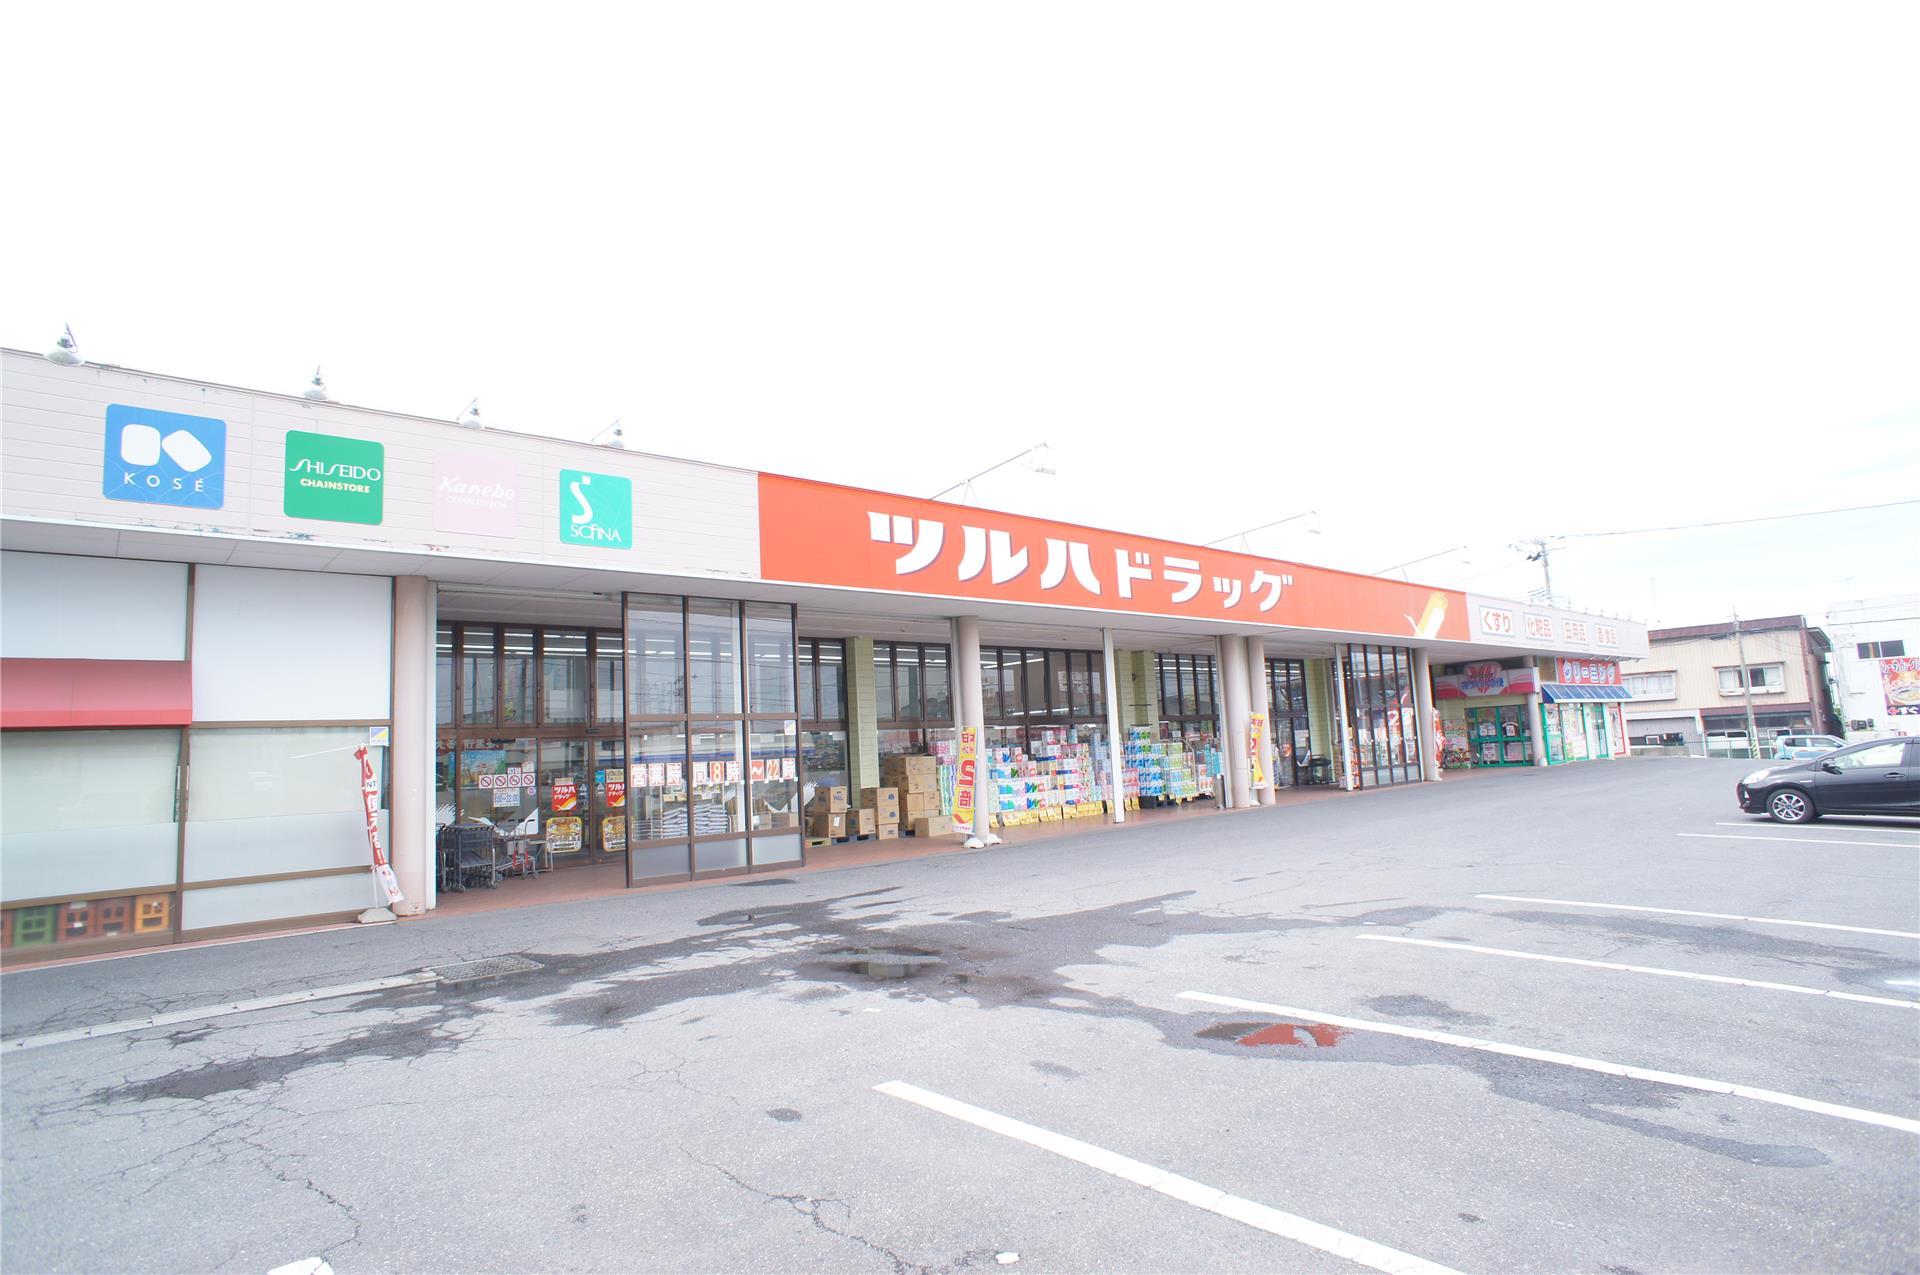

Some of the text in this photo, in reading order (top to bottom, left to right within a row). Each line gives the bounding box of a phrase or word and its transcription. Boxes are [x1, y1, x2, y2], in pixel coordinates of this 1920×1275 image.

[289, 458, 381, 482] SHISEIDO
[124, 471, 204, 493] KOSÉ
[299, 477, 371, 494] CHAINSTORE
[437, 476, 515, 501] Kanebo
[866, 510, 1294, 613] ツルハドラッグ
[1483, 611, 1511, 633] くすり
[554, 786, 576, 794] ツルハ
